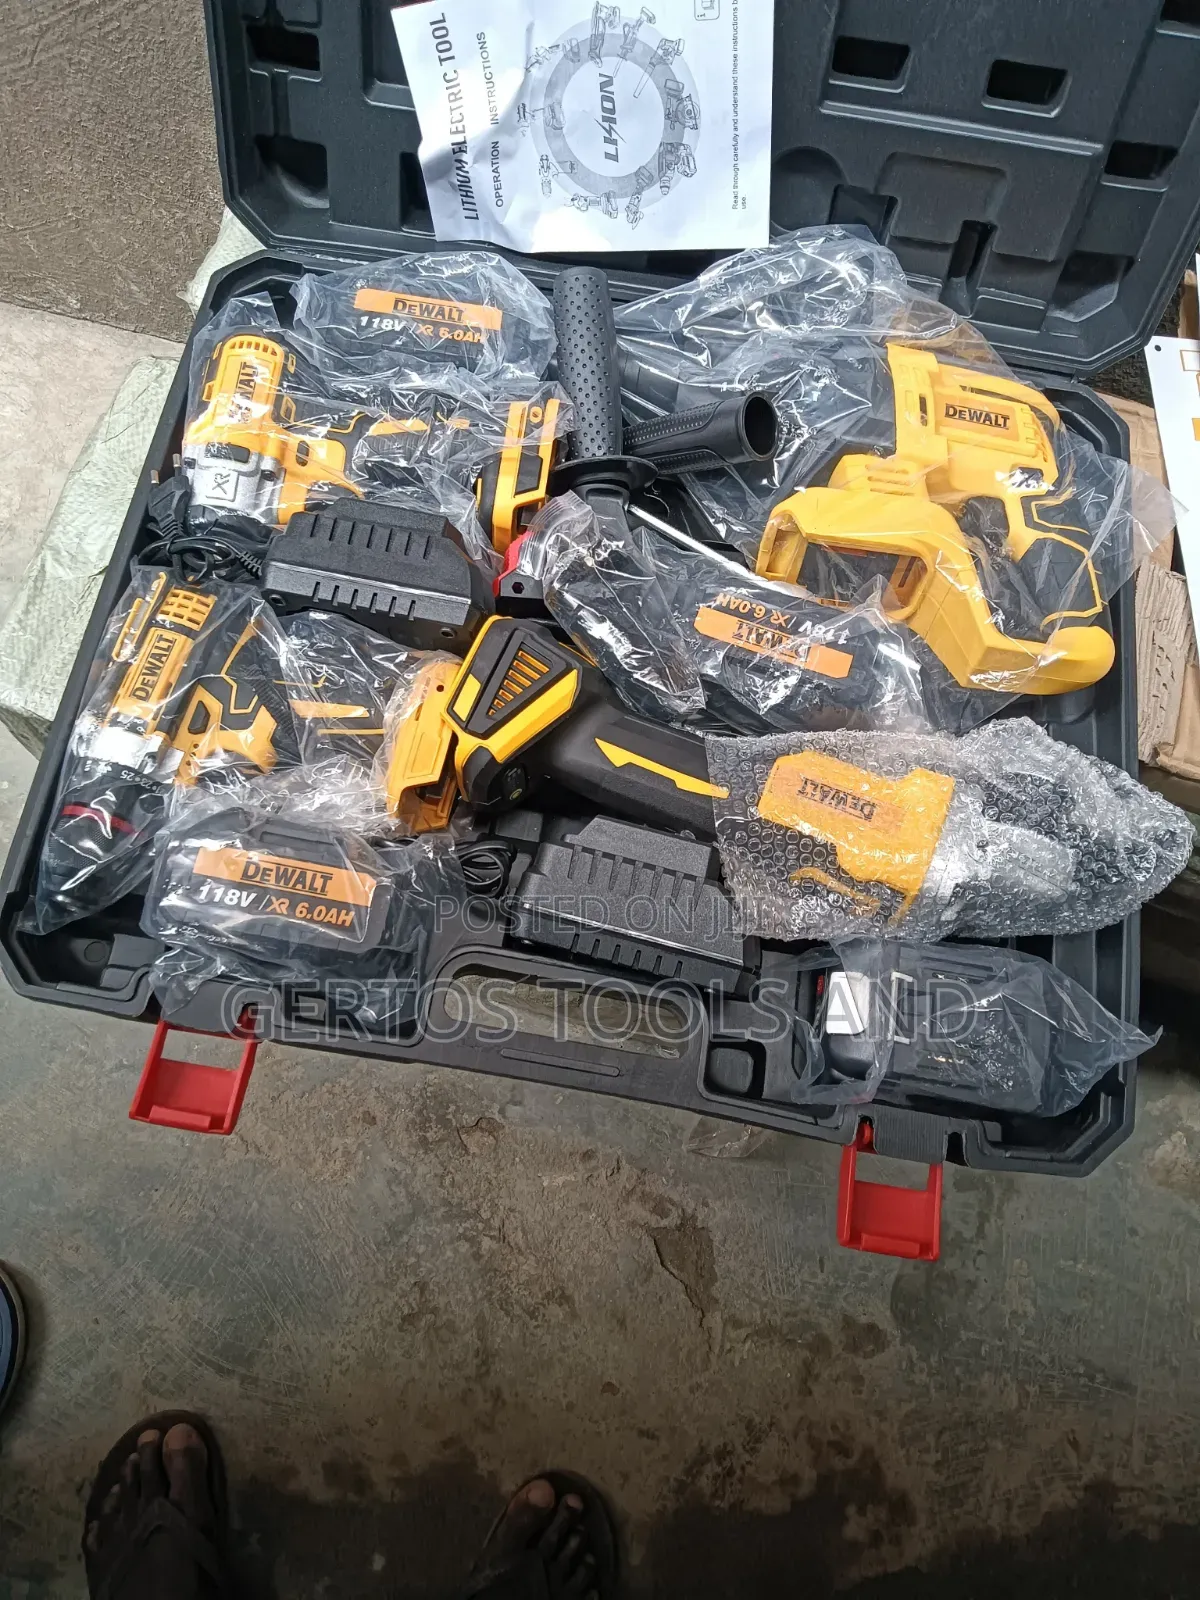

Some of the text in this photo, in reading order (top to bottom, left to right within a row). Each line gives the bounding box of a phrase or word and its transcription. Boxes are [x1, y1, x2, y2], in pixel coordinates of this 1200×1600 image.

[429, 12, 479, 220] LITHIUM ELECTRIC TOOL
[476, 31, 503, 207] OPERATION INSTRUCTIONS
[360, 315, 406, 331] 118V
[716, 593, 766, 619] 6.0AH
[199, 884, 257, 907] 118V
[295, 902, 355, 927] 6.0AH
